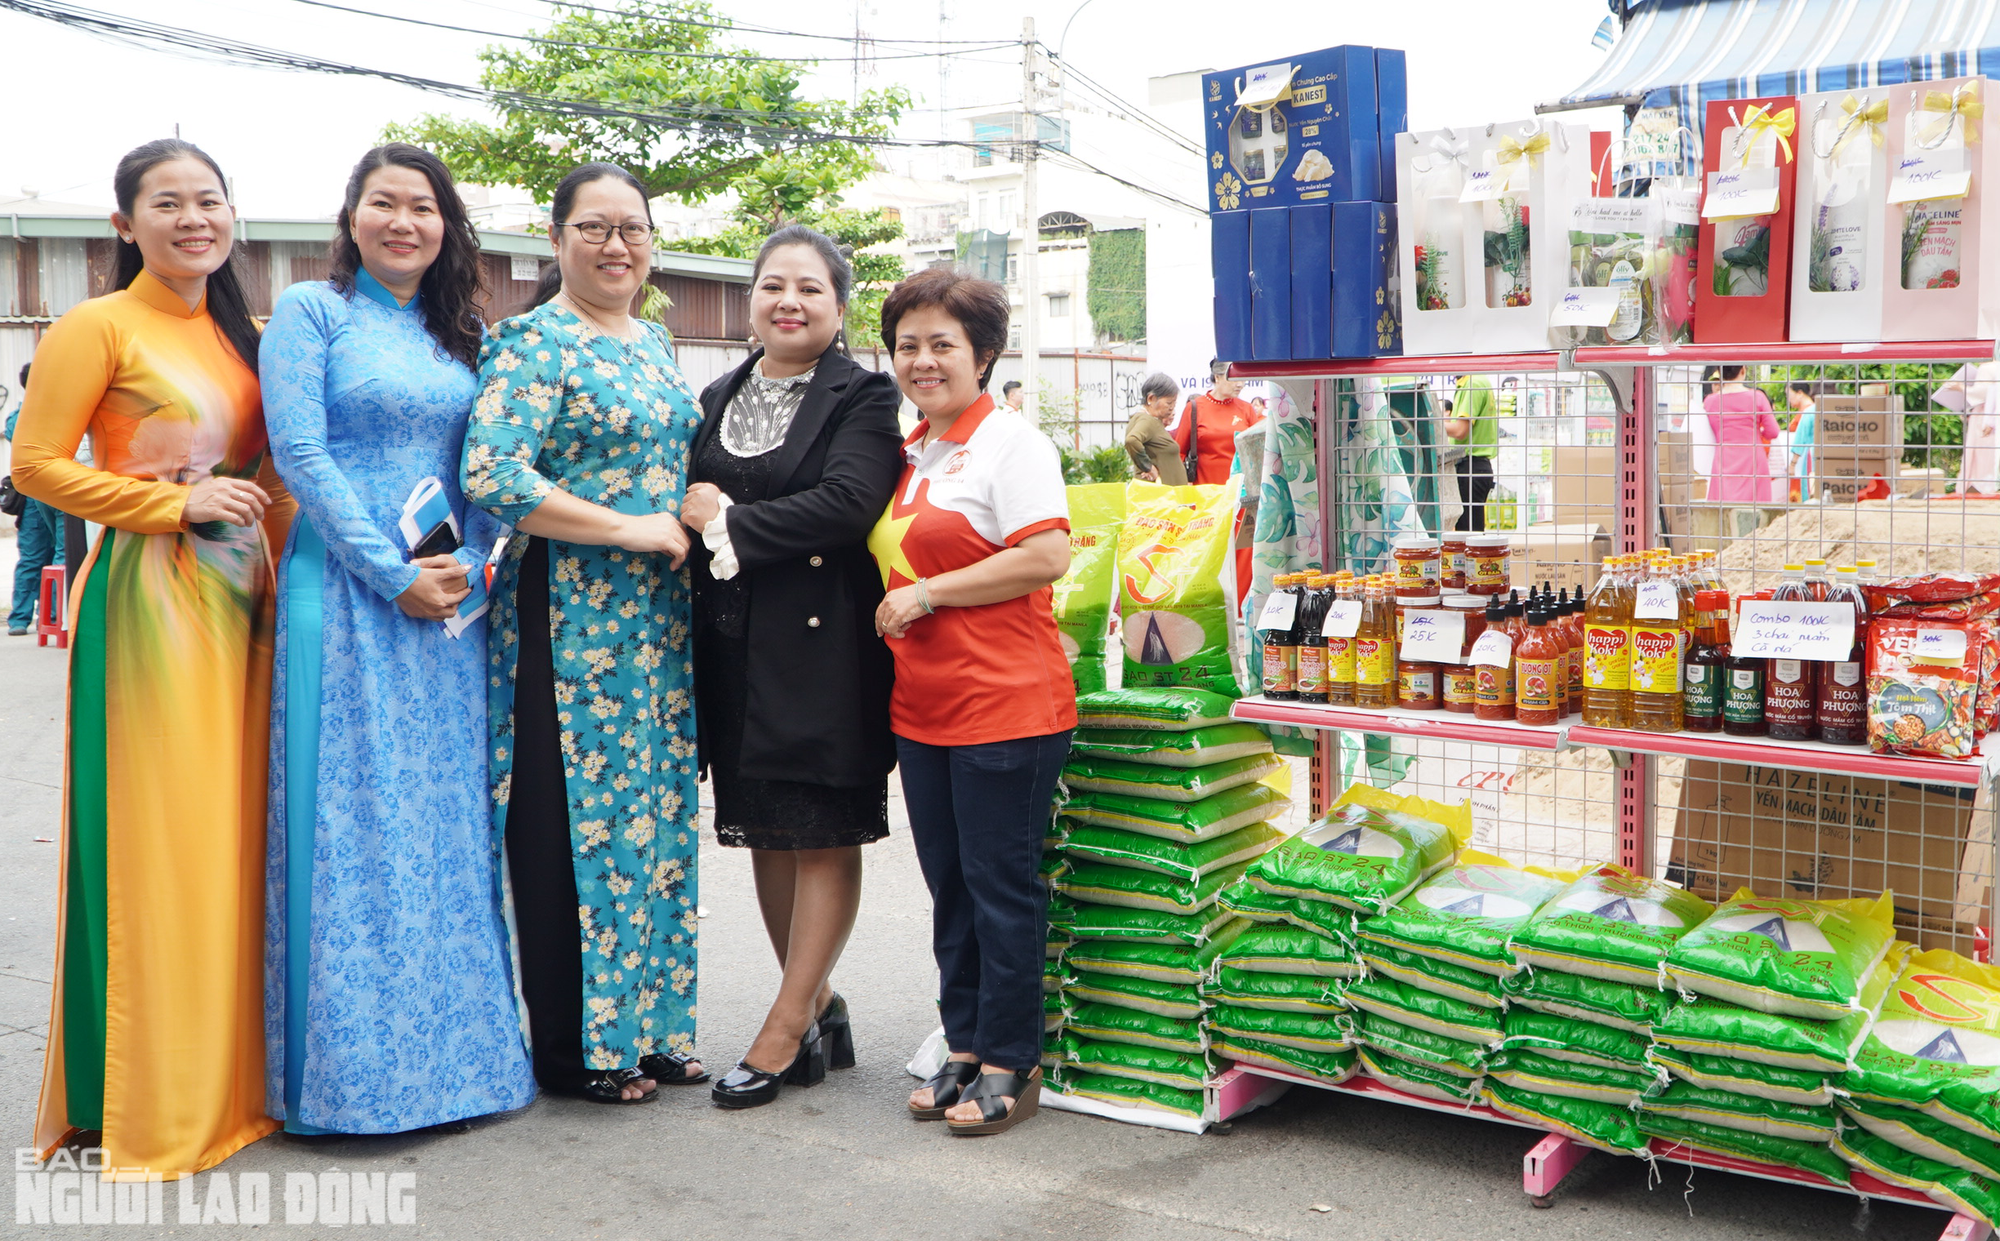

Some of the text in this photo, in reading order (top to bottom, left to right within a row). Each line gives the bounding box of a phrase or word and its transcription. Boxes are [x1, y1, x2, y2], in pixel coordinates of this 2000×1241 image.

[1293, 89, 1324, 104] KANEST
[1643, 597, 1670, 608] 40K
[1750, 612, 1791, 624] Combo
[1409, 630, 1437, 642] 25K
[1588, 632, 1624, 647] happi
[1752, 629, 1761, 640] 3
[1636, 635, 1673, 650] happi
[1589, 643, 1617, 656] Koki
[1638, 646, 1666, 659] Koki
[1154, 671, 1174, 682] ST
[1179, 665, 1211, 682] 24
[1685, 685, 1704, 694] HOA
[1775, 686, 1800, 698] HOA
[1833, 689, 1859, 701] HOA
[1733, 692, 1753, 701] HOA
[1767, 696, 1811, 710] PHƯỢNG
[1726, 699, 1761, 711] PHƯỢNG
[1823, 700, 1867, 713] PHƯỢNG
[1887, 701, 1913, 713] Tôm
[1745, 766, 1885, 814] HAZELINE
[1756, 789, 1777, 809] YẾN
[1323, 853, 1349, 864] ST
[1352, 857, 1387, 876] 24
[1639, 926, 1678, 942] 24
[1793, 953, 1834, 971] 24
